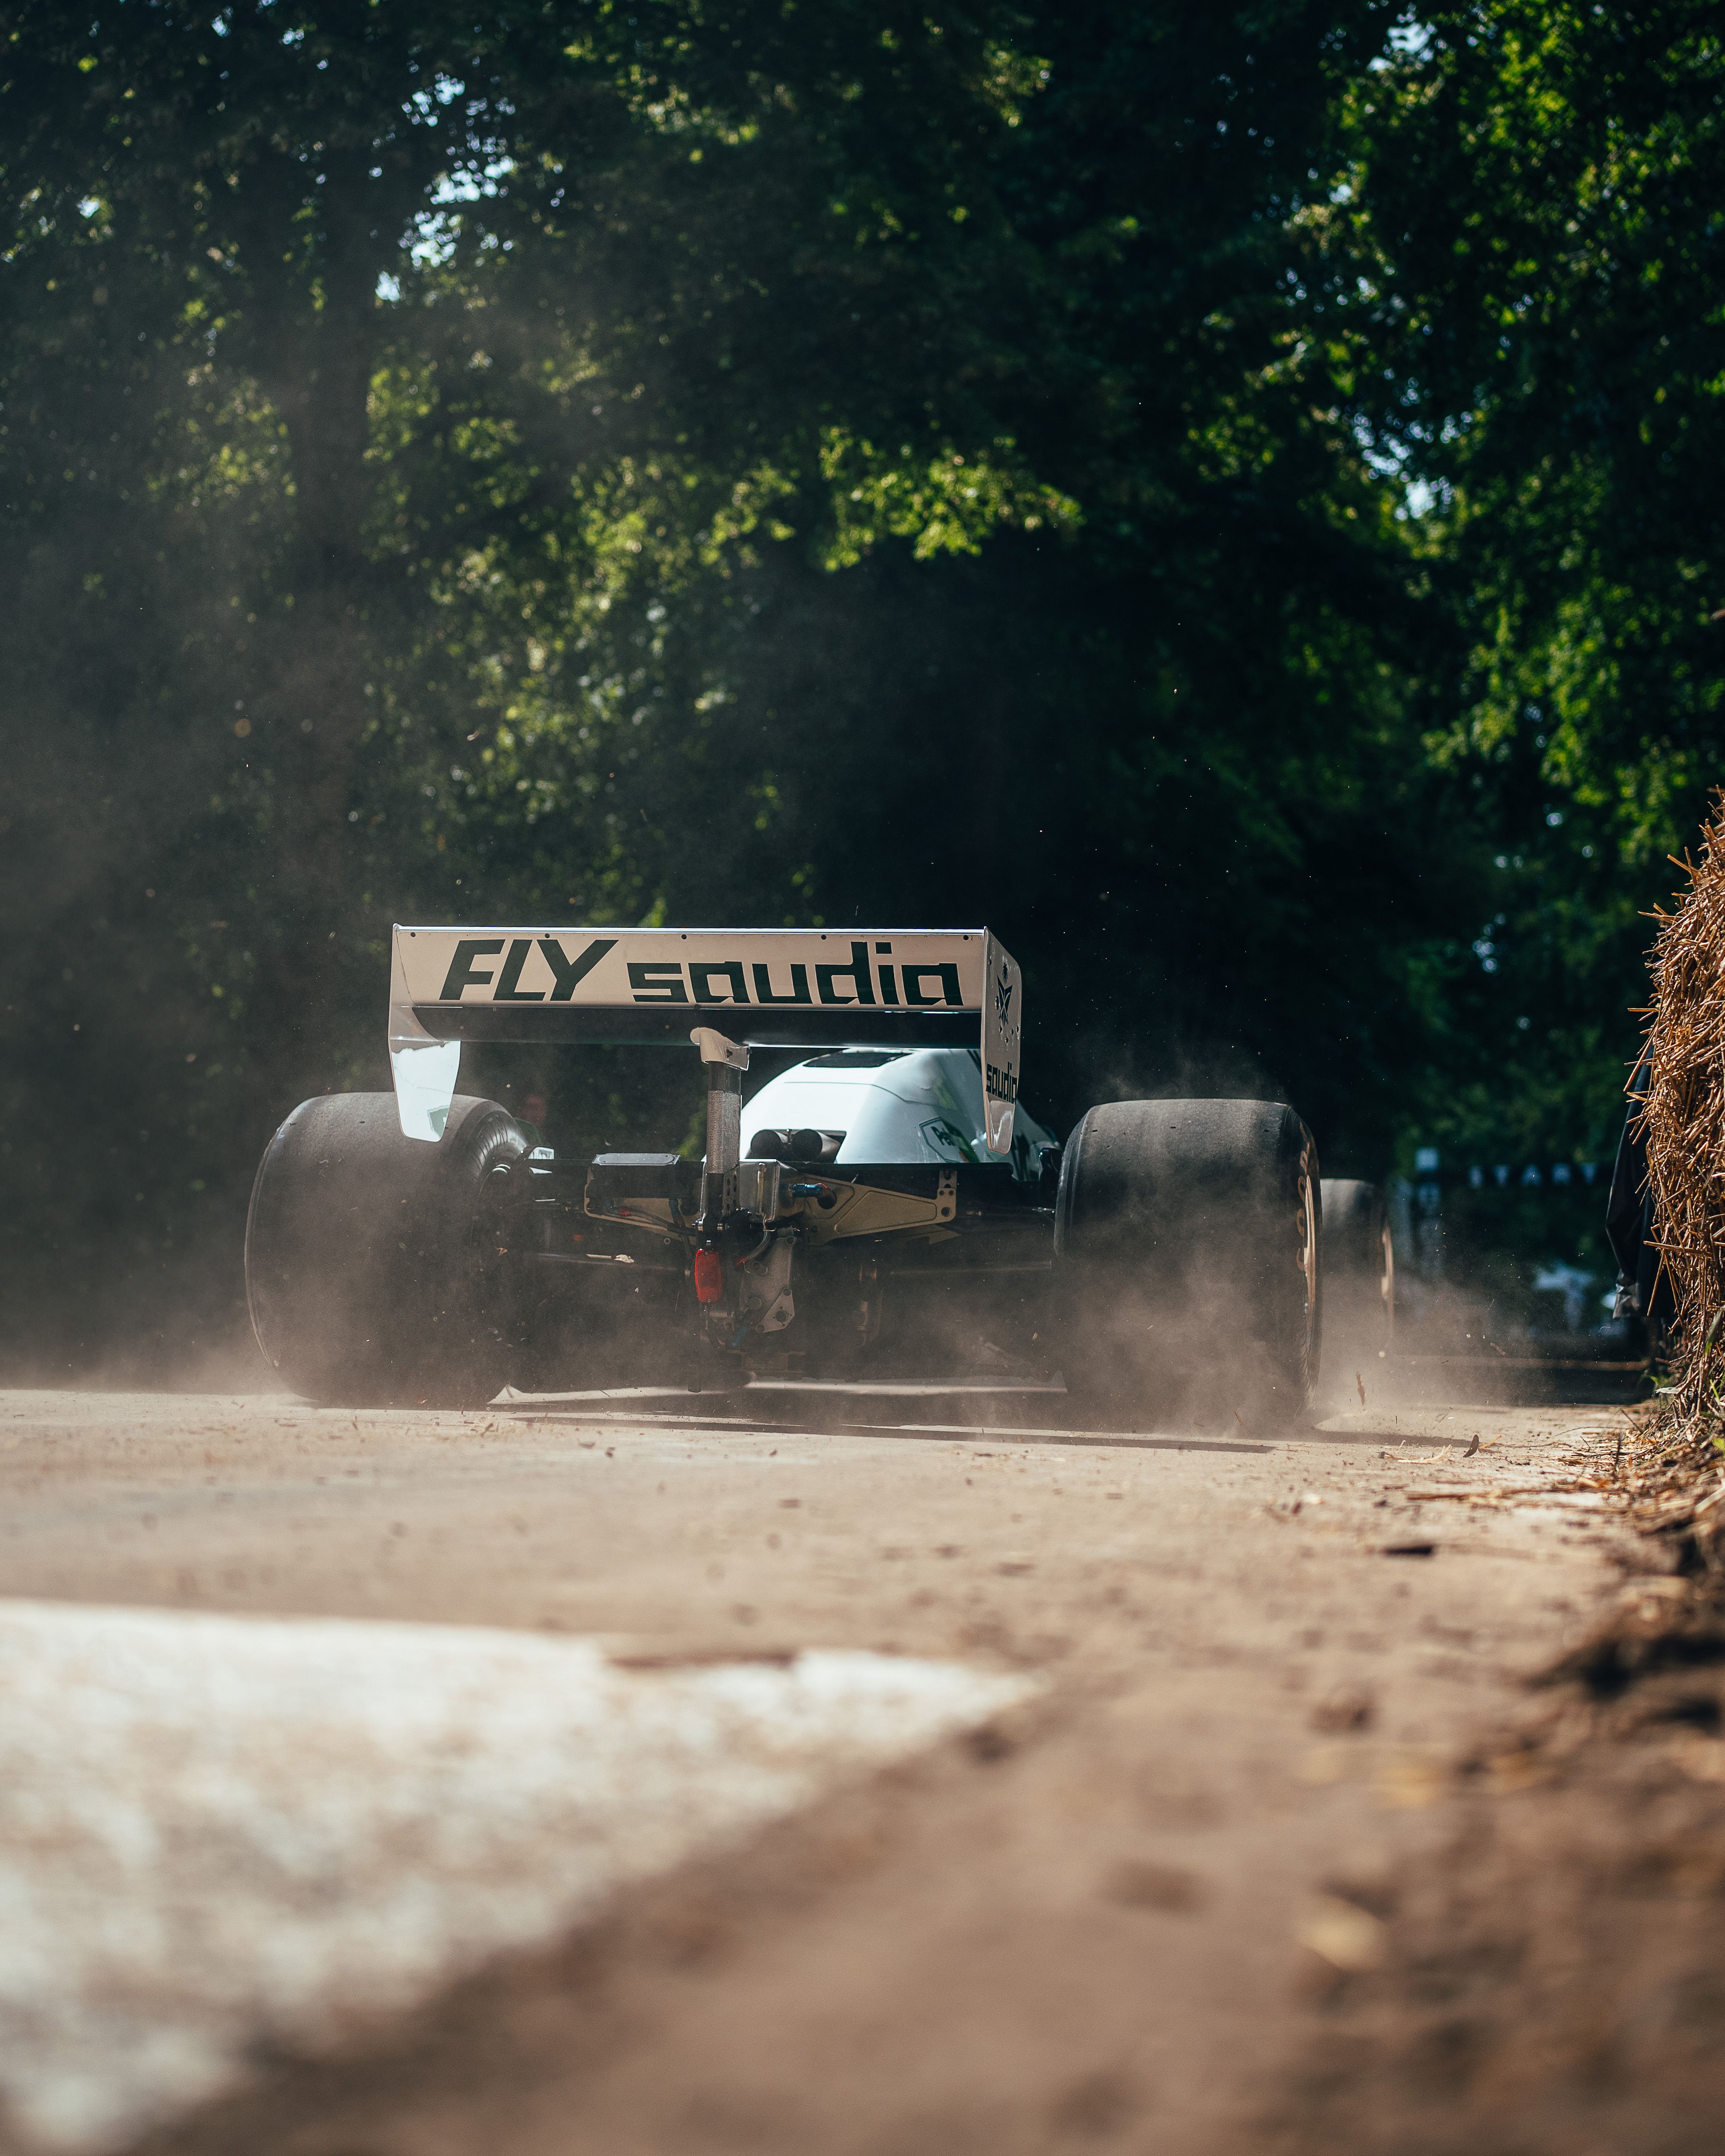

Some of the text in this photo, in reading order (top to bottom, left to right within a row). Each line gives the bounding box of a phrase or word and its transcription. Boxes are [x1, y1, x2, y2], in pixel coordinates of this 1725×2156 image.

[439, 939, 964, 1006] FLY saudia
[985, 1061, 1018, 1105] saudia
